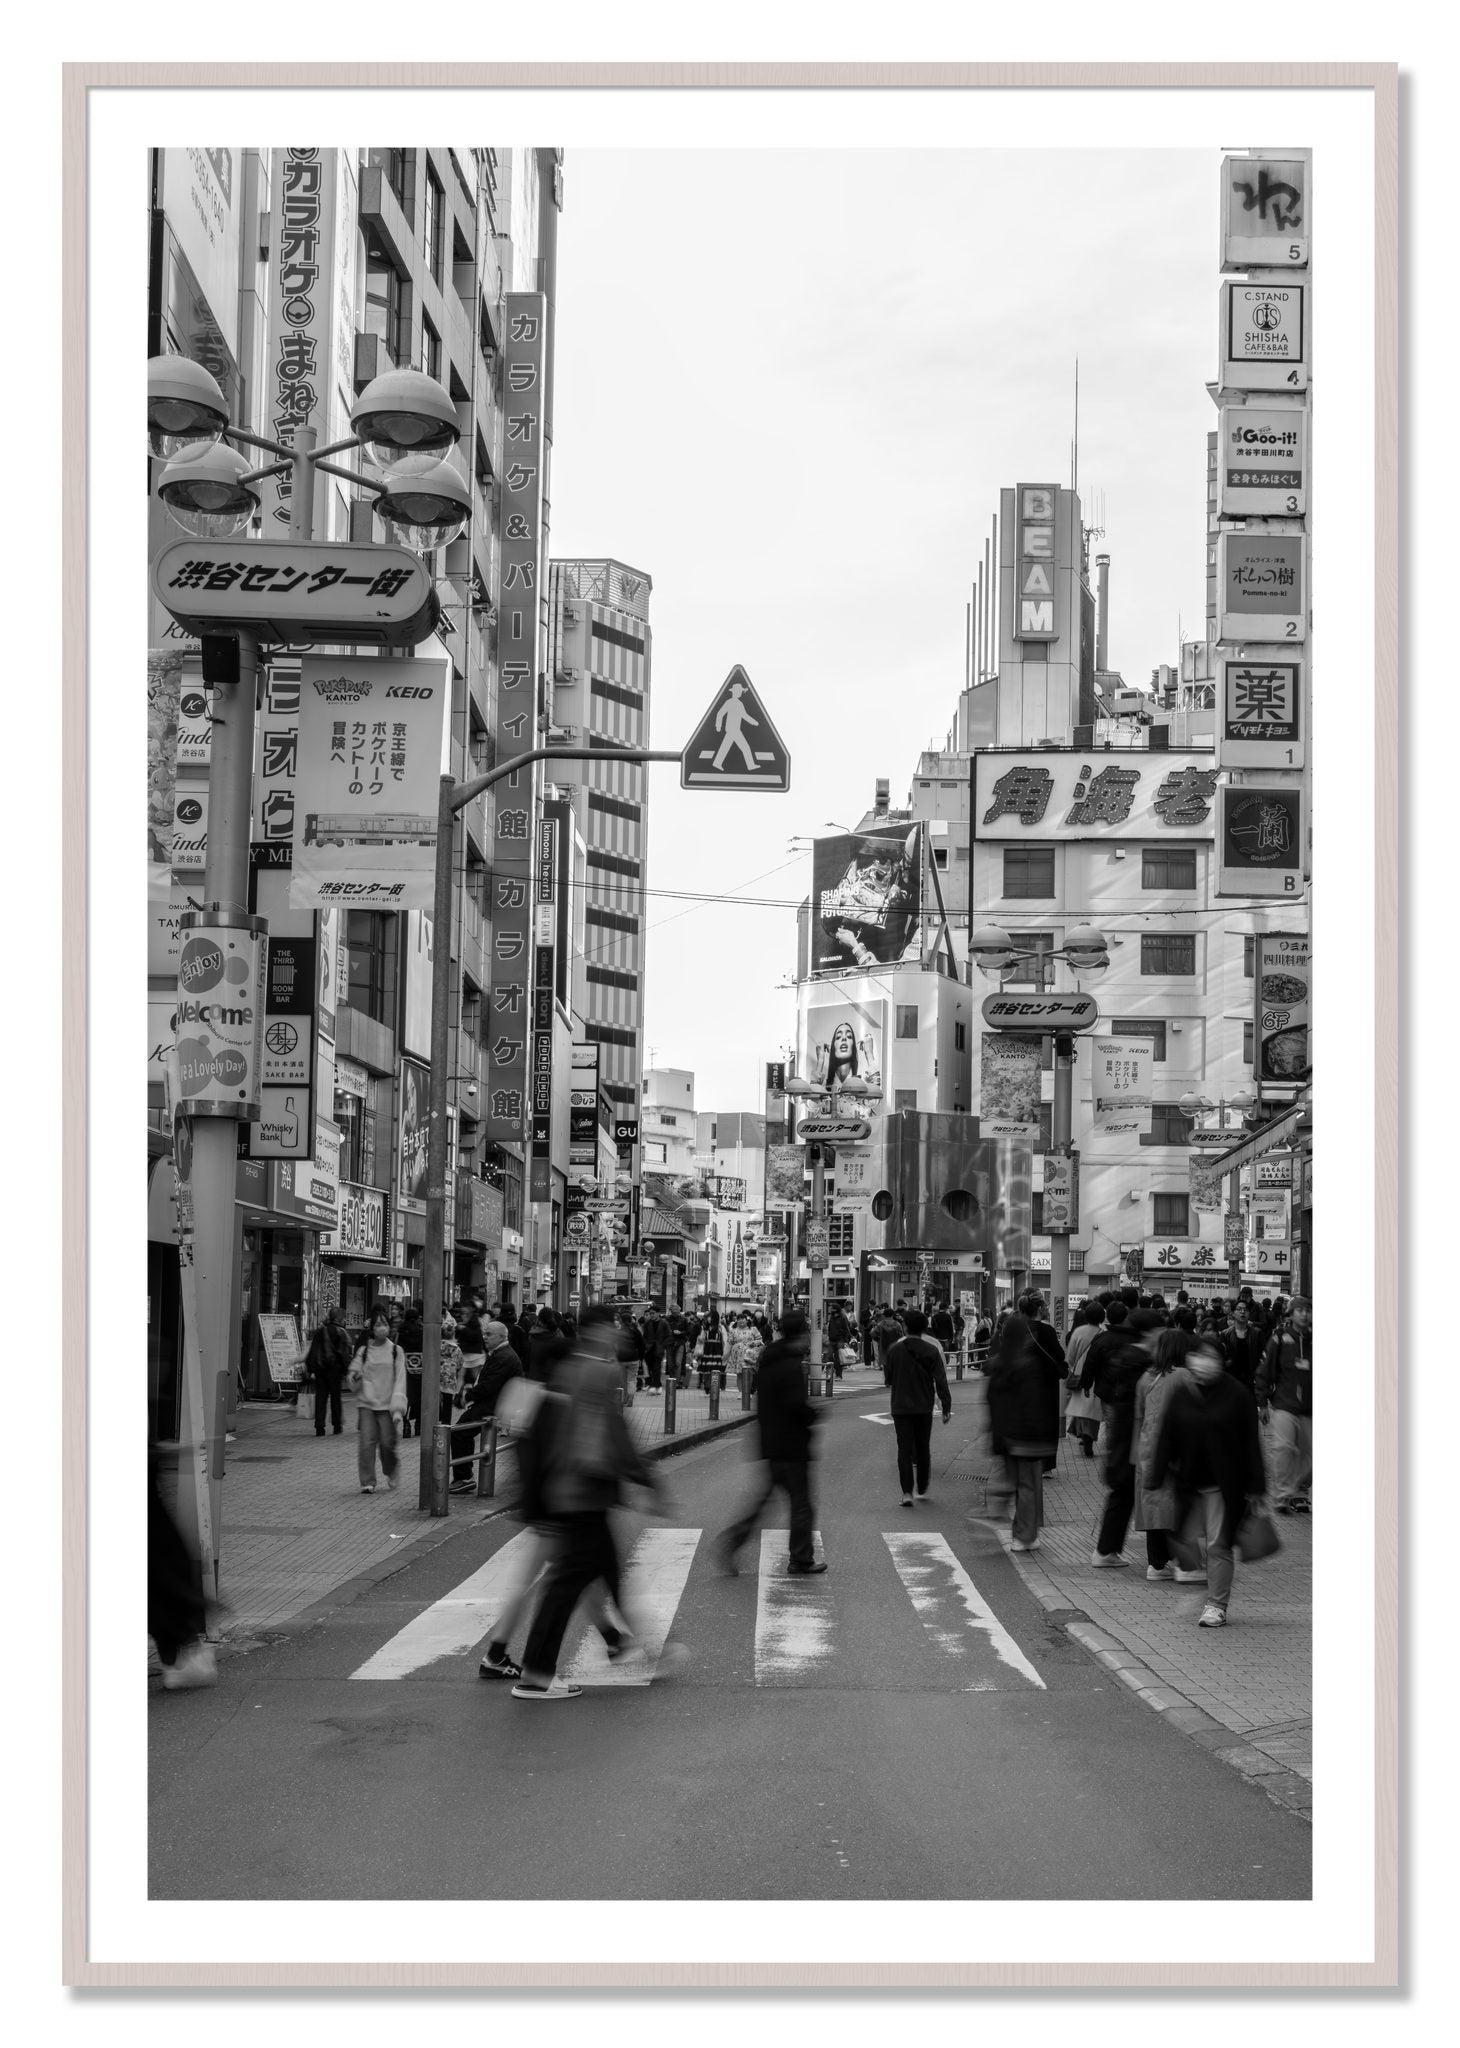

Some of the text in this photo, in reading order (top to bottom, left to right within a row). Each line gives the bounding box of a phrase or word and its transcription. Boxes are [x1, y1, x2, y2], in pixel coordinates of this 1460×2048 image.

[281, 161, 322, 297] カラオケ
[1288, 244, 1301, 260] 5
[1244, 291, 1289, 302] C.STAND
[1244, 332, 1289, 343] SHISHA
[1287, 370, 1300, 385] 4
[1243, 429, 1297, 445] Goo-it!
[1231, 473, 1298, 485] 全身もみほぐし
[1286, 496, 1298, 512] 3
[1022, 489, 1053, 632] BEAM
[168, 560, 415, 597] 渋谷センター街
[1285, 622, 1297, 637] 2
[385, 686, 434, 700] KEIO
[1235, 669, 1285, 720] 薬
[1229, 723, 1291, 738] マツモトキヨシ
[330, 721, 347, 764] 冒険へ
[348, 721, 367, 795] カントーの
[369, 721, 387, 795] ポケパーク
[390, 722, 408, 782] 京王線で
[1285, 749, 1294, 764] 1
[982, 765, 1221, 826] 角海老
[543, 824, 552, 859] kimono
[318, 883, 406, 895] 渋谷センター街
[1284, 876, 1296, 891] B
[180, 951, 221, 985] Enjoy
[273, 957, 295, 965] THIRD
[272, 985, 294, 993] ROOM
[177, 1000, 254, 1026] Welcome
[989, 1002, 1092, 1016] 渋谷センター街
[1262, 1011, 1291, 1031] 6F
[194, 1057, 225, 1078] Lovely
[225, 1059, 246, 1073] Day!
[261, 1123, 294, 1135] Whisky
[617, 1126, 637, 1138] GU
[800, 1124, 862, 1133] 渋谷センター街
[260, 1132, 280, 1141] Bank
